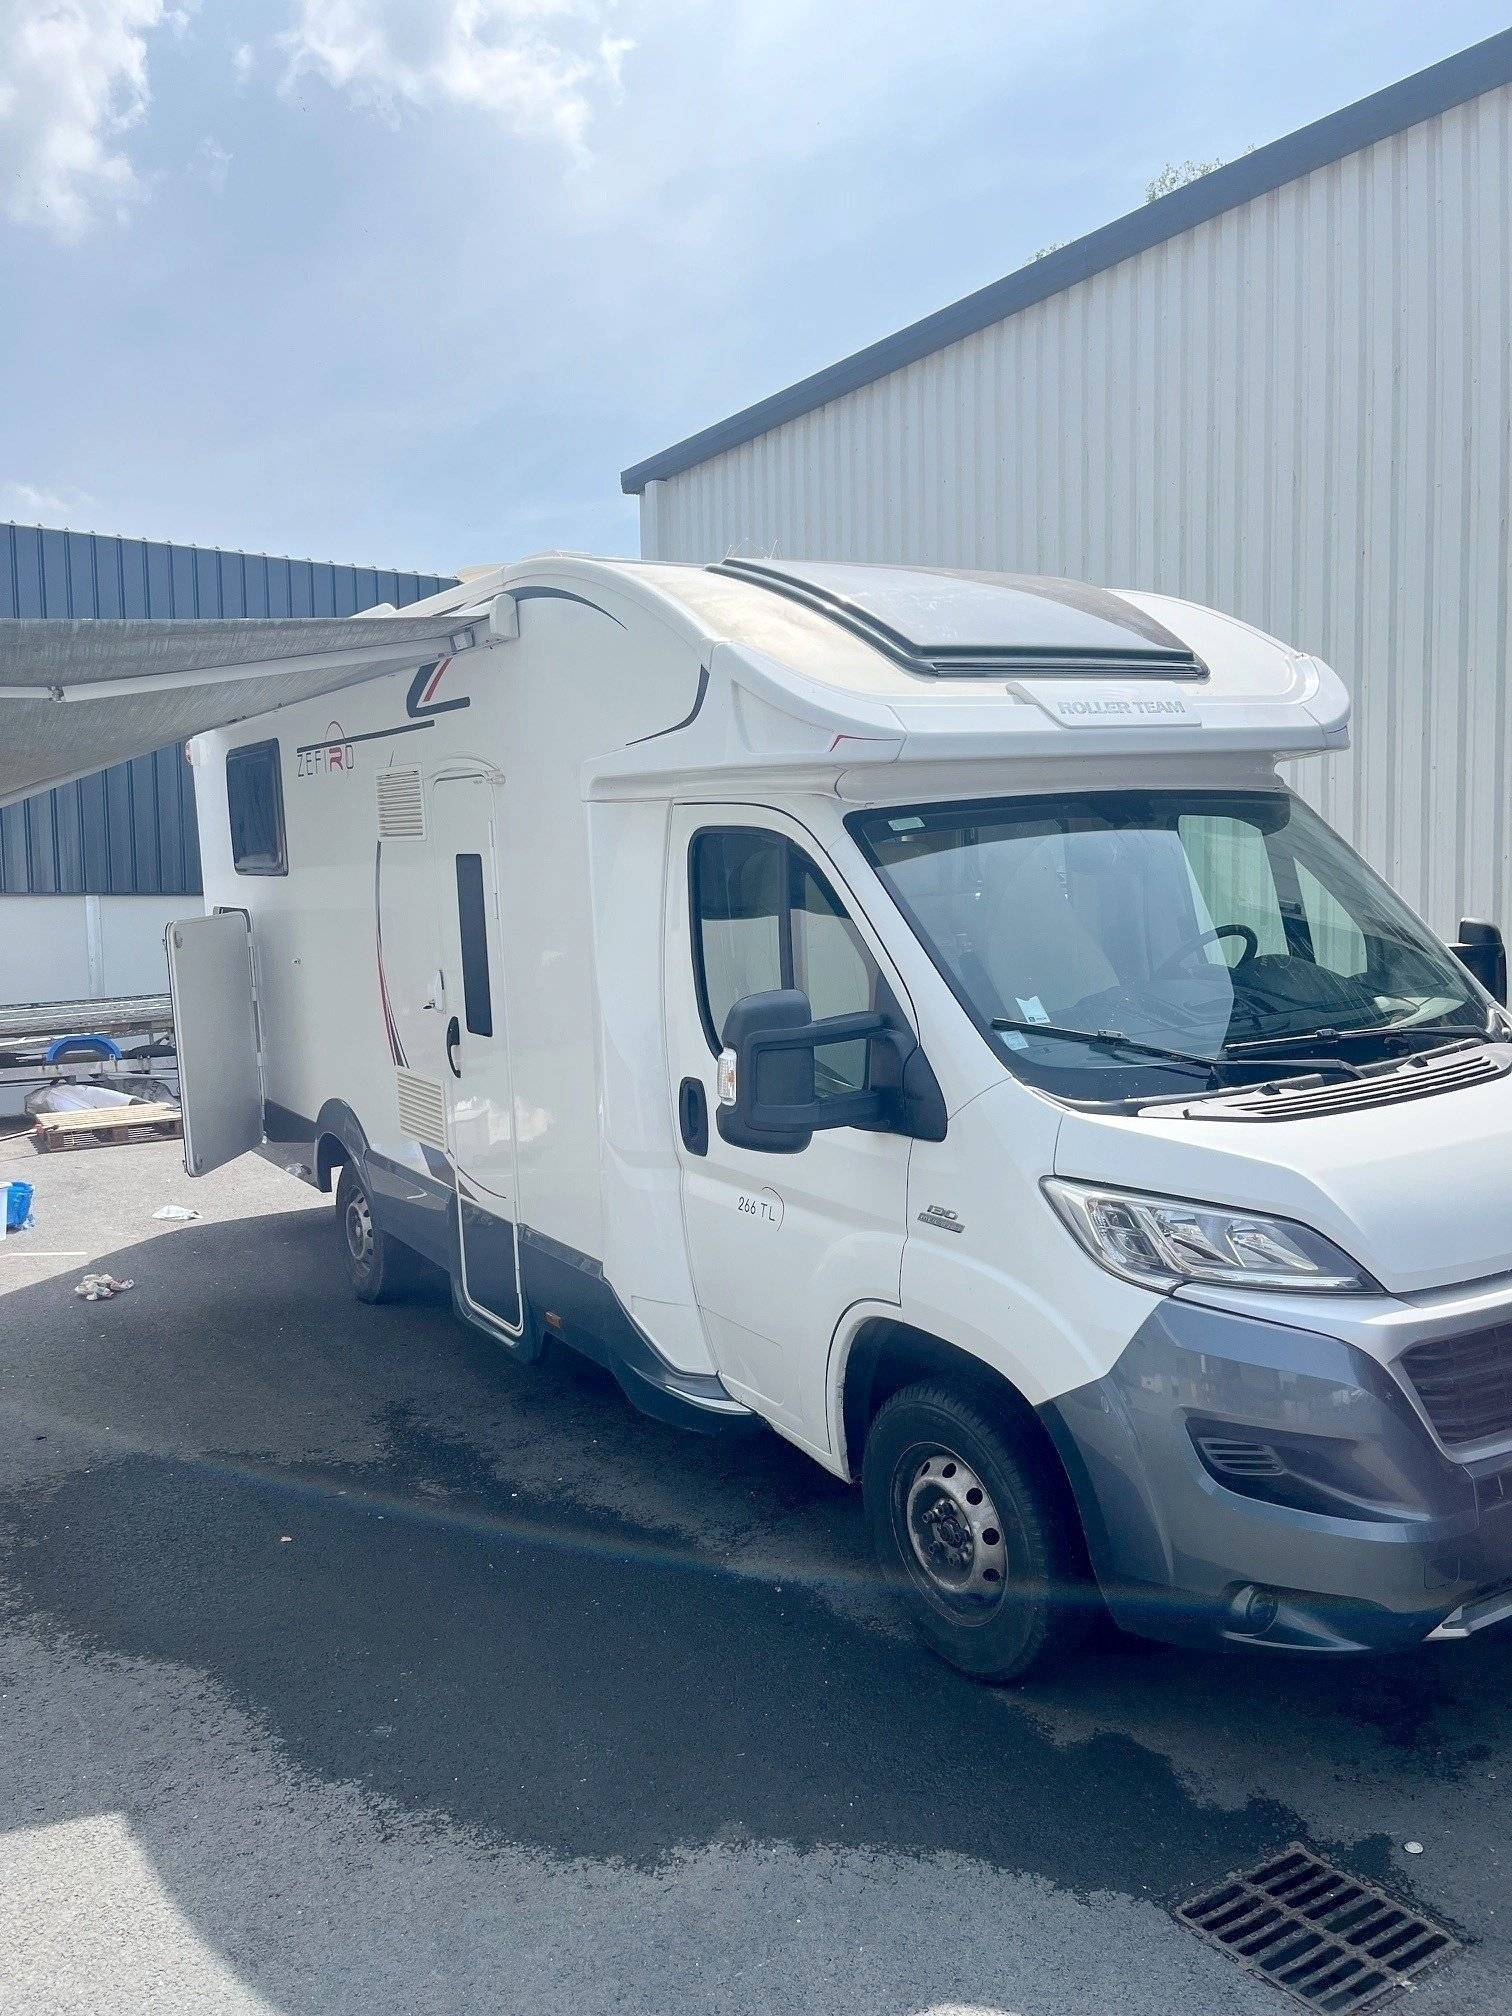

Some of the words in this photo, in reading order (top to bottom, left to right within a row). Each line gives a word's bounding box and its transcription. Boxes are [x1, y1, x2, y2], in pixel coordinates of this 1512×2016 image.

[1057, 701, 1131, 715] ROLLER
[1134, 700, 1186, 714] TEAM
[297, 744, 355, 777] ZEFIRO
[738, 1196, 755, 1215] 266
[760, 1202, 776, 1222] TL
